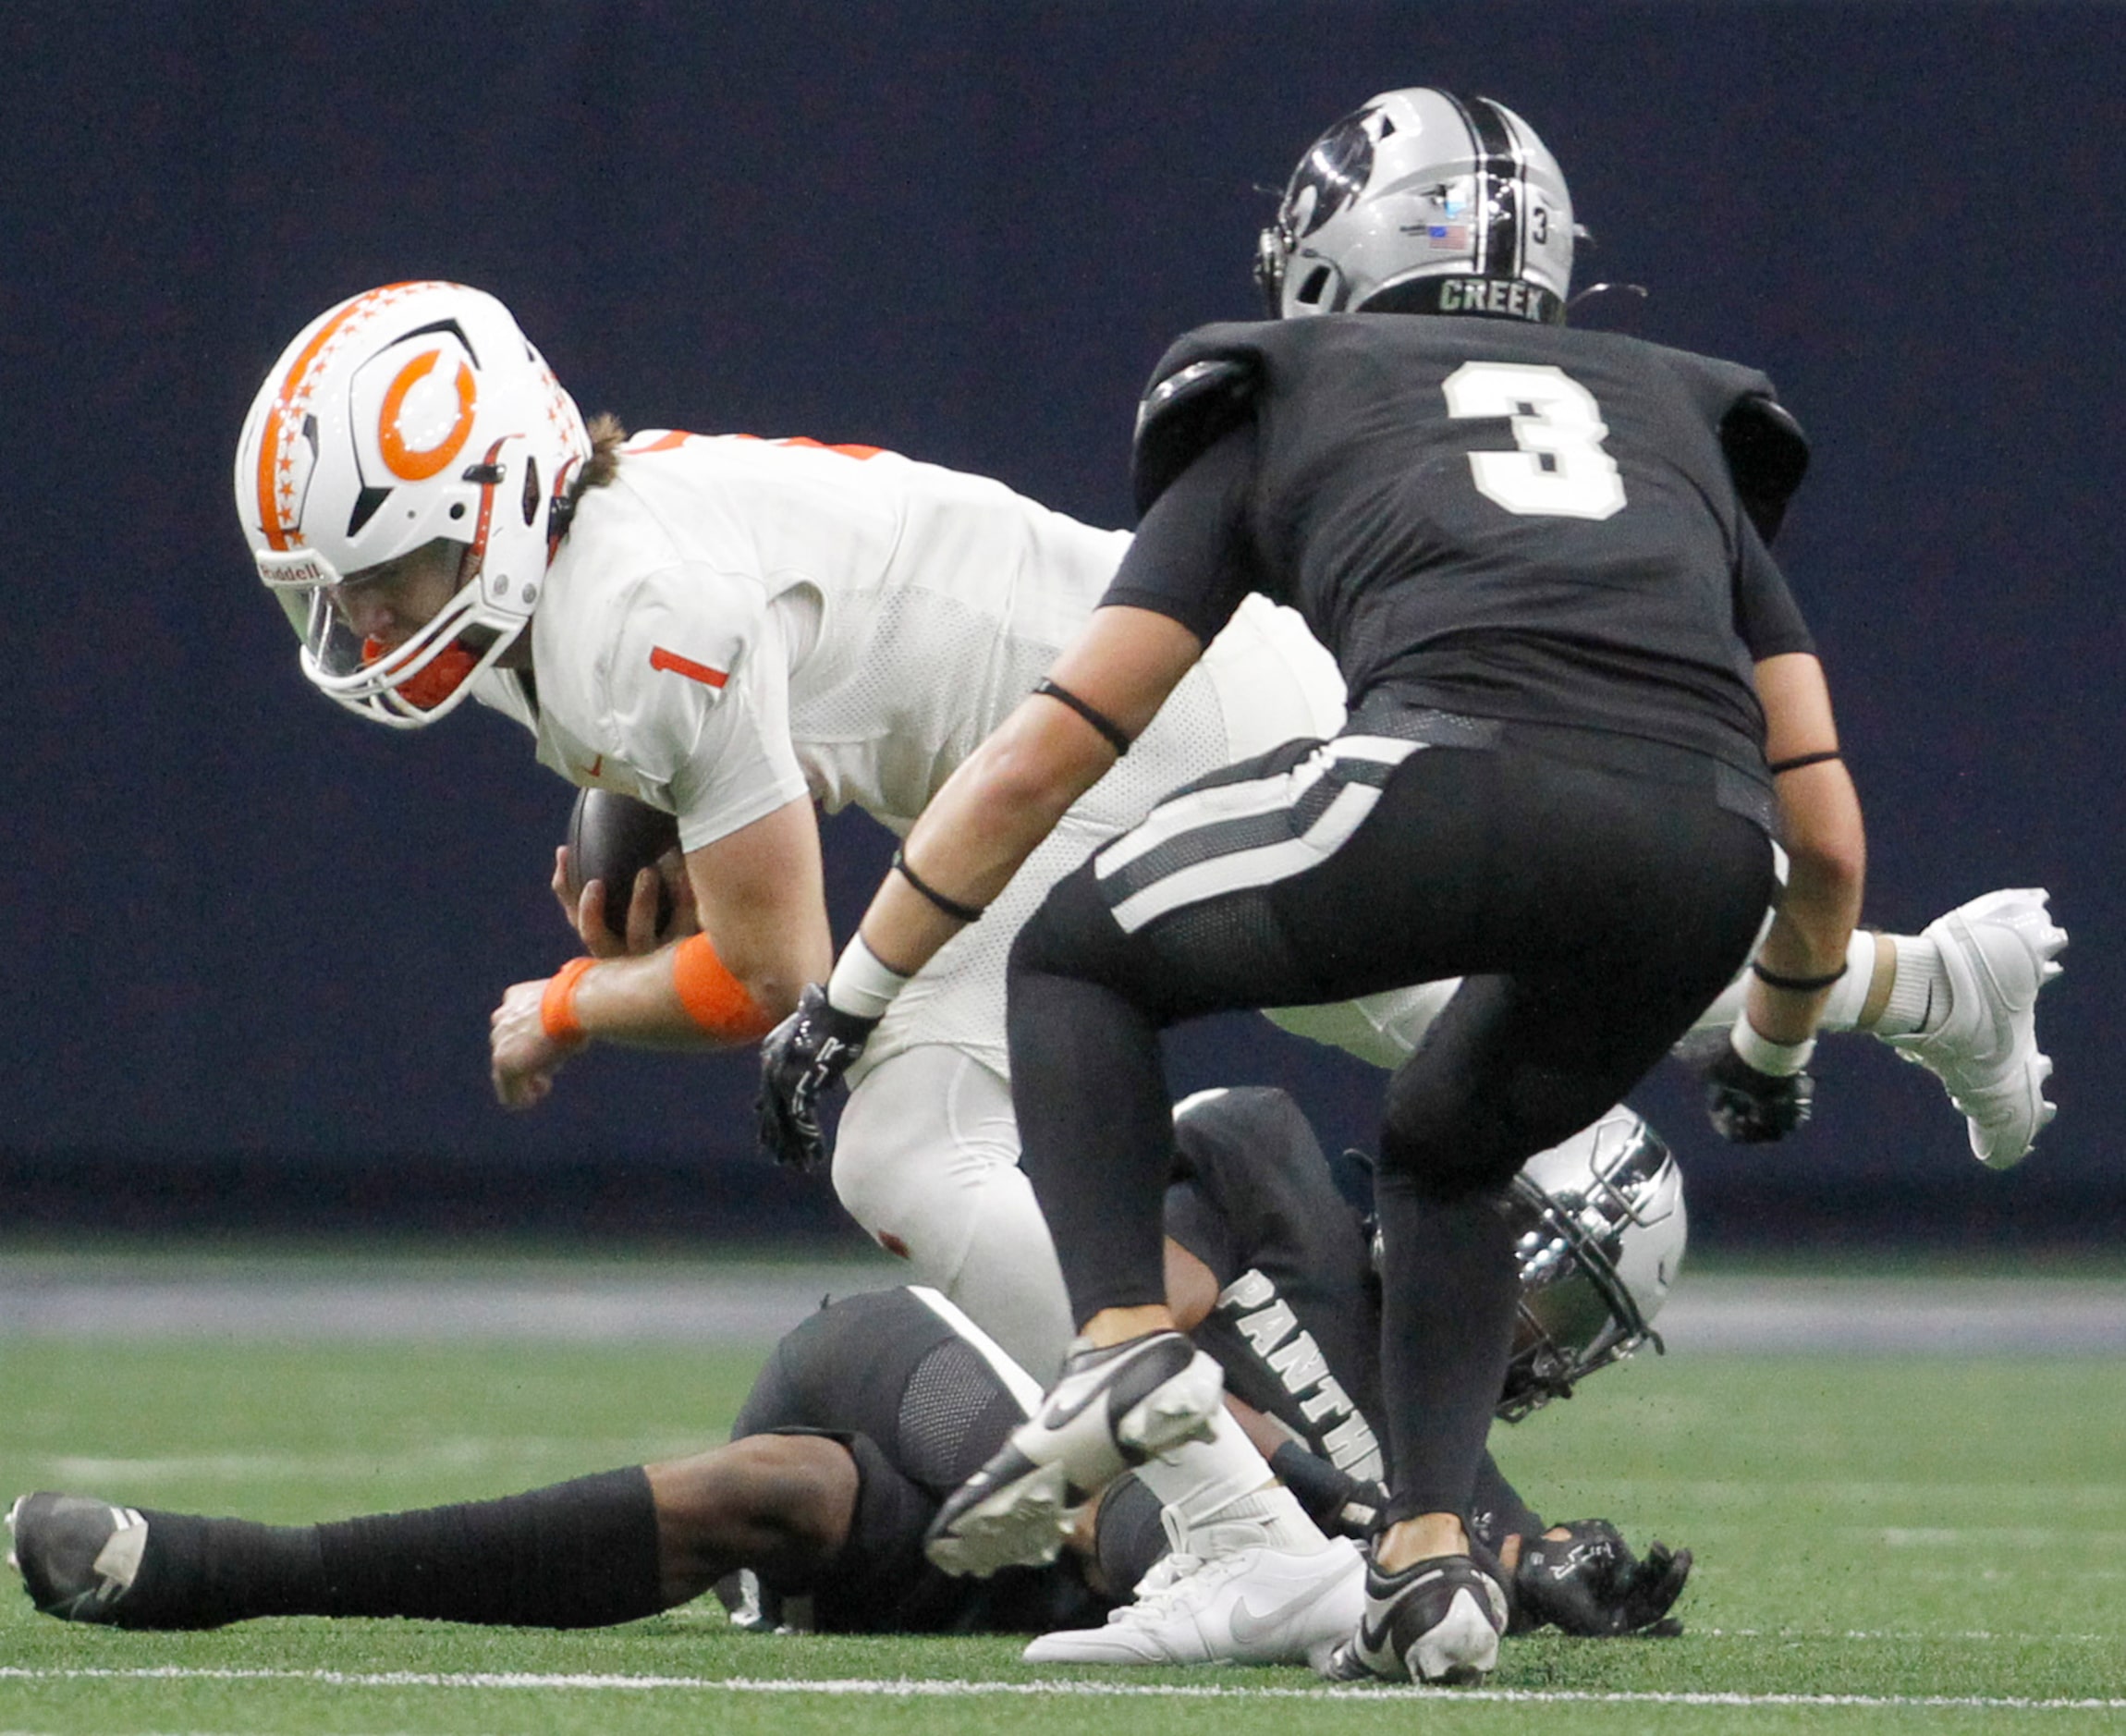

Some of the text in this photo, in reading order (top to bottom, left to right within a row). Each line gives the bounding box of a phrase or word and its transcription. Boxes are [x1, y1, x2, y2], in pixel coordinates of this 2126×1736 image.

[1533, 206, 1548, 245] 3
[1439, 278, 1544, 322] CREEK
[379, 349, 477, 482] C
[1441, 361, 1628, 521] 3
[650, 645, 729, 690] 1
[1216, 1268, 1391, 1498] PANTH
